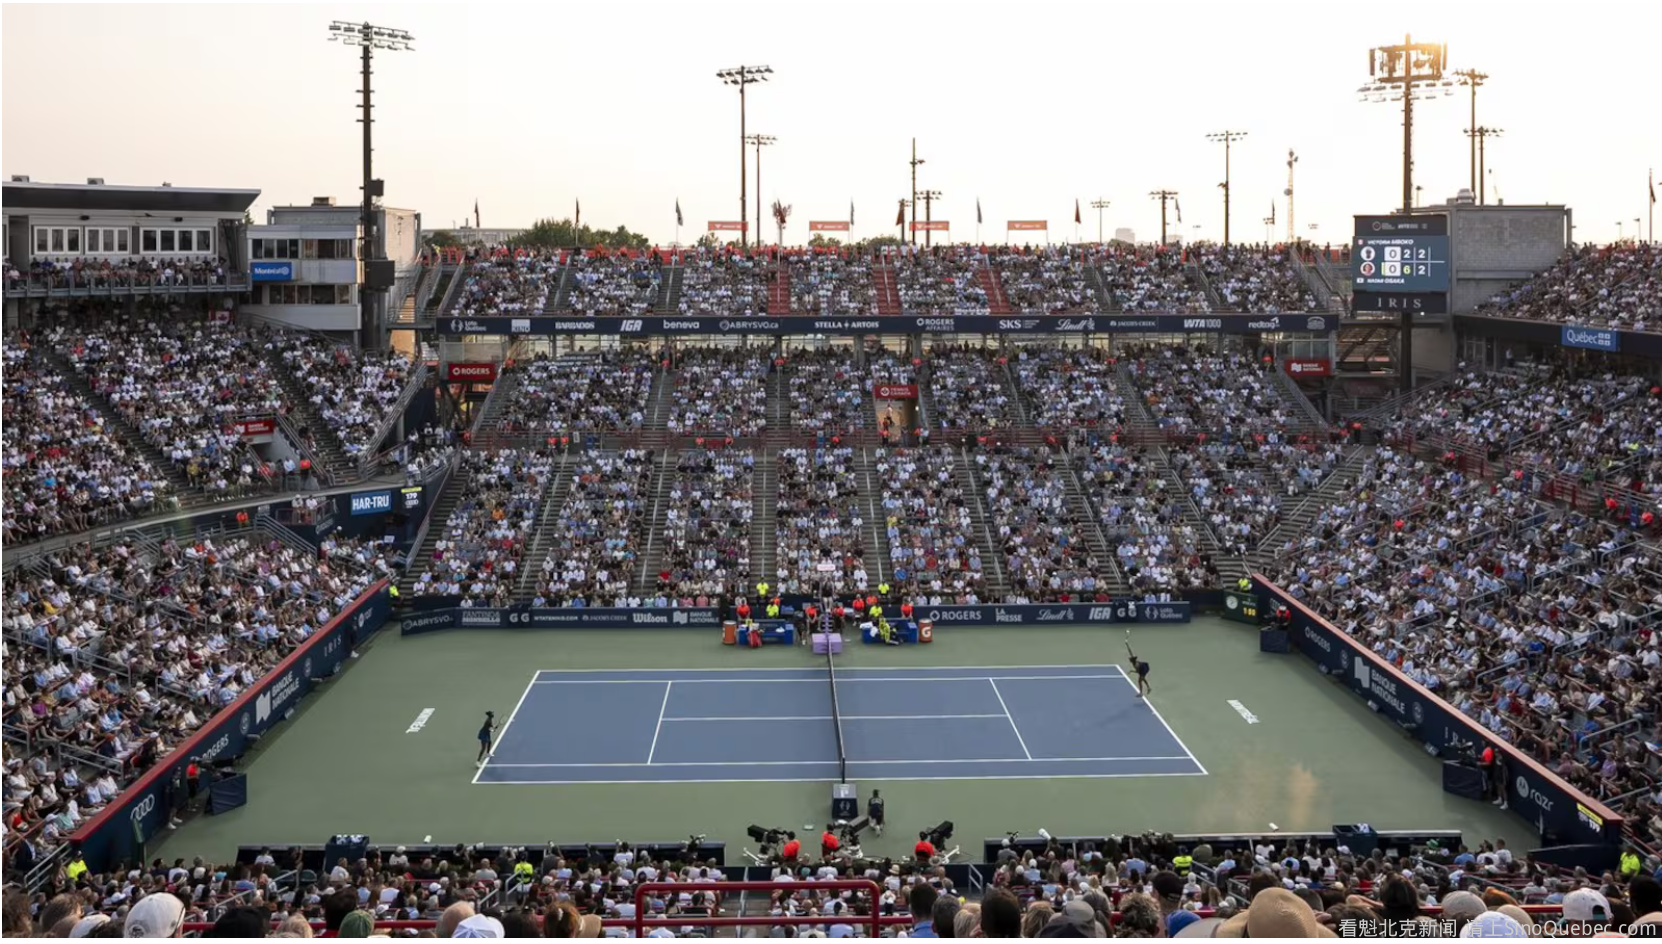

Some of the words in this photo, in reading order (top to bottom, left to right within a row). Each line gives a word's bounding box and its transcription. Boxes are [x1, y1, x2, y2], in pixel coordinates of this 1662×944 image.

[1389, 249, 1397, 259] 0
[1403, 249, 1411, 259] 2
[1418, 249, 1426, 259] 2
[1389, 264, 1397, 274] 0
[1403, 265, 1411, 275] 6
[1418, 265, 1426, 275] 2
[1377, 297, 1422, 308] IRIS
[620, 319, 643, 332] IGA
[663, 319, 700, 329] beneva
[925, 318, 955, 326] ROGERS
[999, 319, 1022, 329] SKS
[1566, 329, 1598, 344] Québec
[461, 367, 490, 375] ROGERS
[352, 495, 390, 511] HAR-TRU
[509, 613, 518, 622] G
[521, 613, 530, 622] G
[633, 612, 668, 623] Wilson
[942, 610, 982, 620] ROGERS
[995, 614, 1023, 622] PRESSE
[1089, 607, 1111, 620] IGA
[921, 627, 931, 637] G
[271, 670, 293, 696] BANQUE
[1371, 669, 1397, 695] BANQUE
[272, 677, 300, 710] NATIONALE
[1371, 683, 1406, 714] NATIONALE
[1530, 789, 1554, 811] razr
